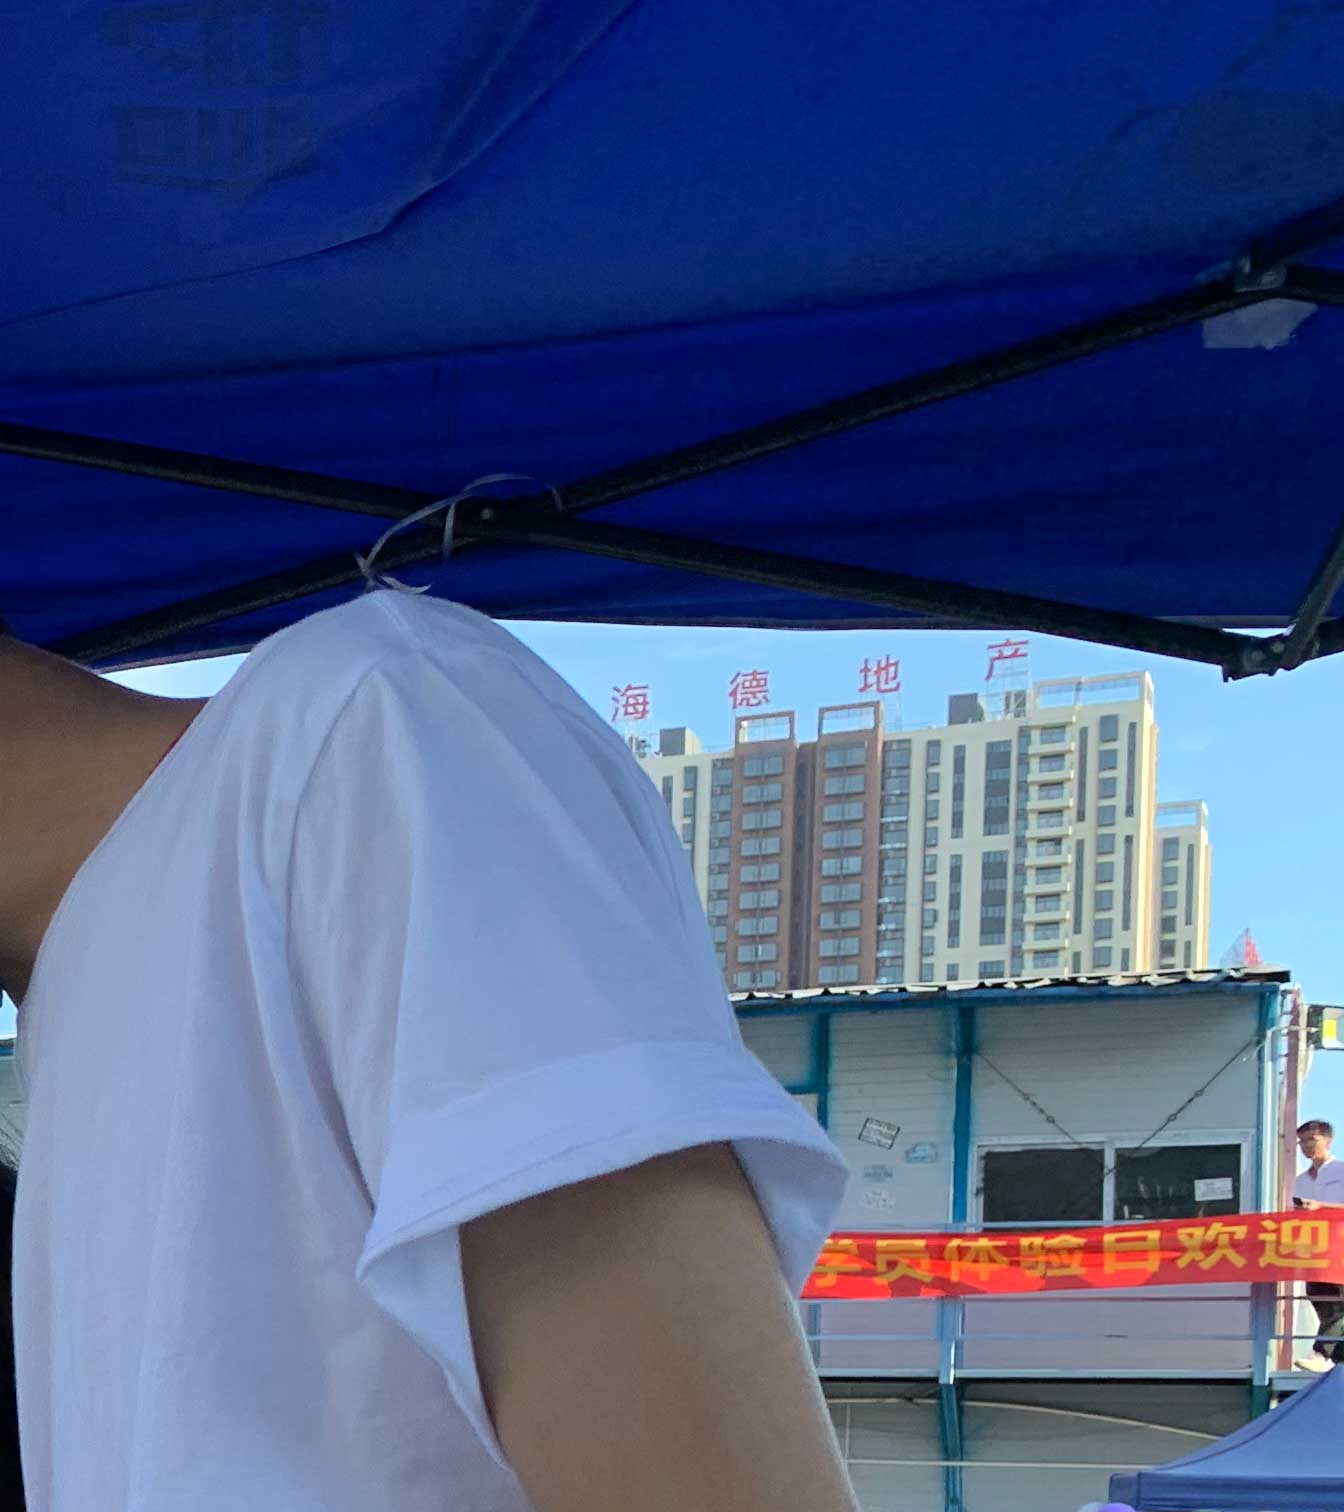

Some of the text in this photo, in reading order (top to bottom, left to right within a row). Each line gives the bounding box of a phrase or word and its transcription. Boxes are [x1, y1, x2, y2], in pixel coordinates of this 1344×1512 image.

[611, 639, 1029, 720] 海德地产
[814, 1219, 1344, 1287] 学员体验日欢迎
